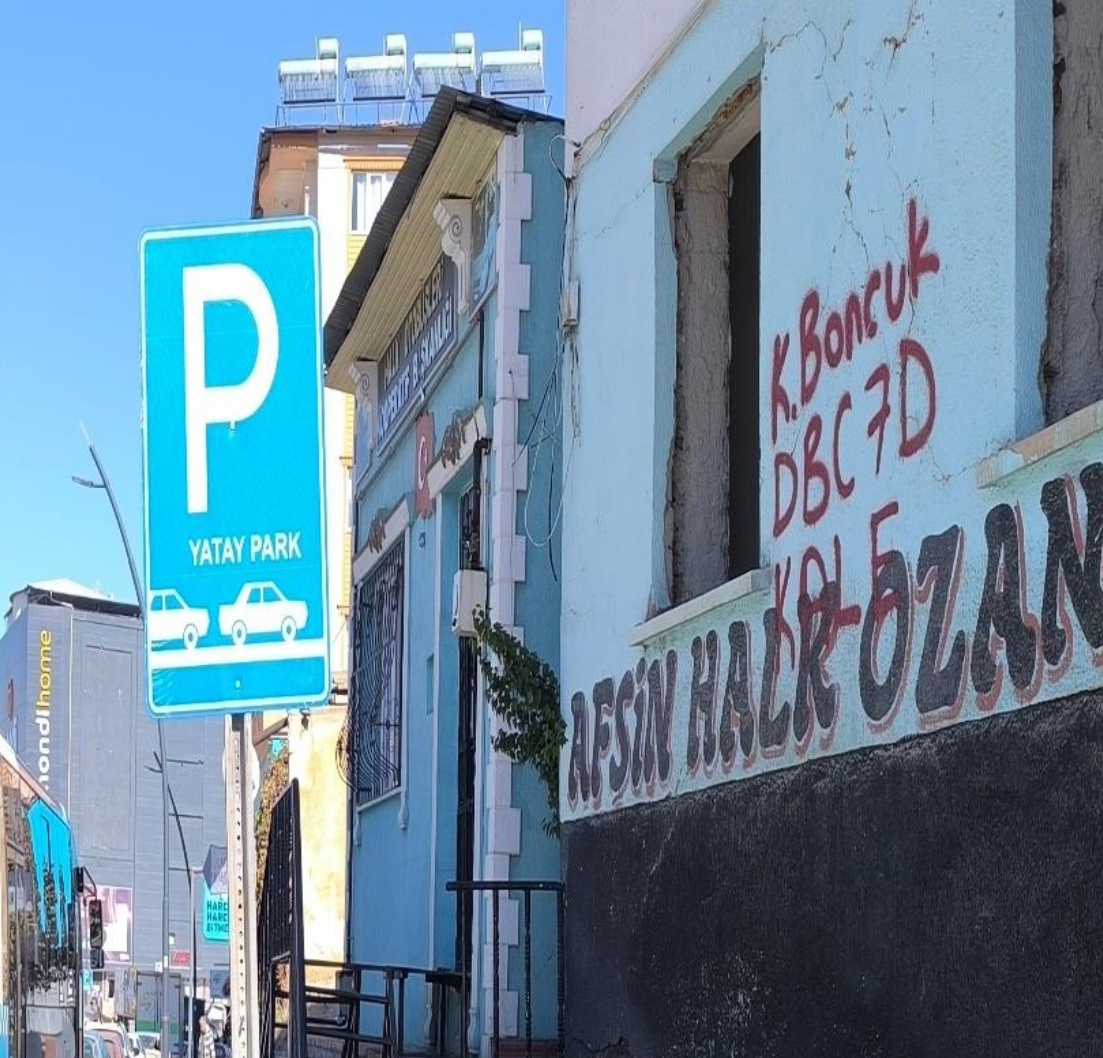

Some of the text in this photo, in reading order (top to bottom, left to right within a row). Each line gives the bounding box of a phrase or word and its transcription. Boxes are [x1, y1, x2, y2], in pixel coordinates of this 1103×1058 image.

[183, 262, 279, 514] P
[189, 531, 302, 567] YATAY PARK
[686, 580, 840, 756] HALK
[206, 900, 228, 911] HARC
